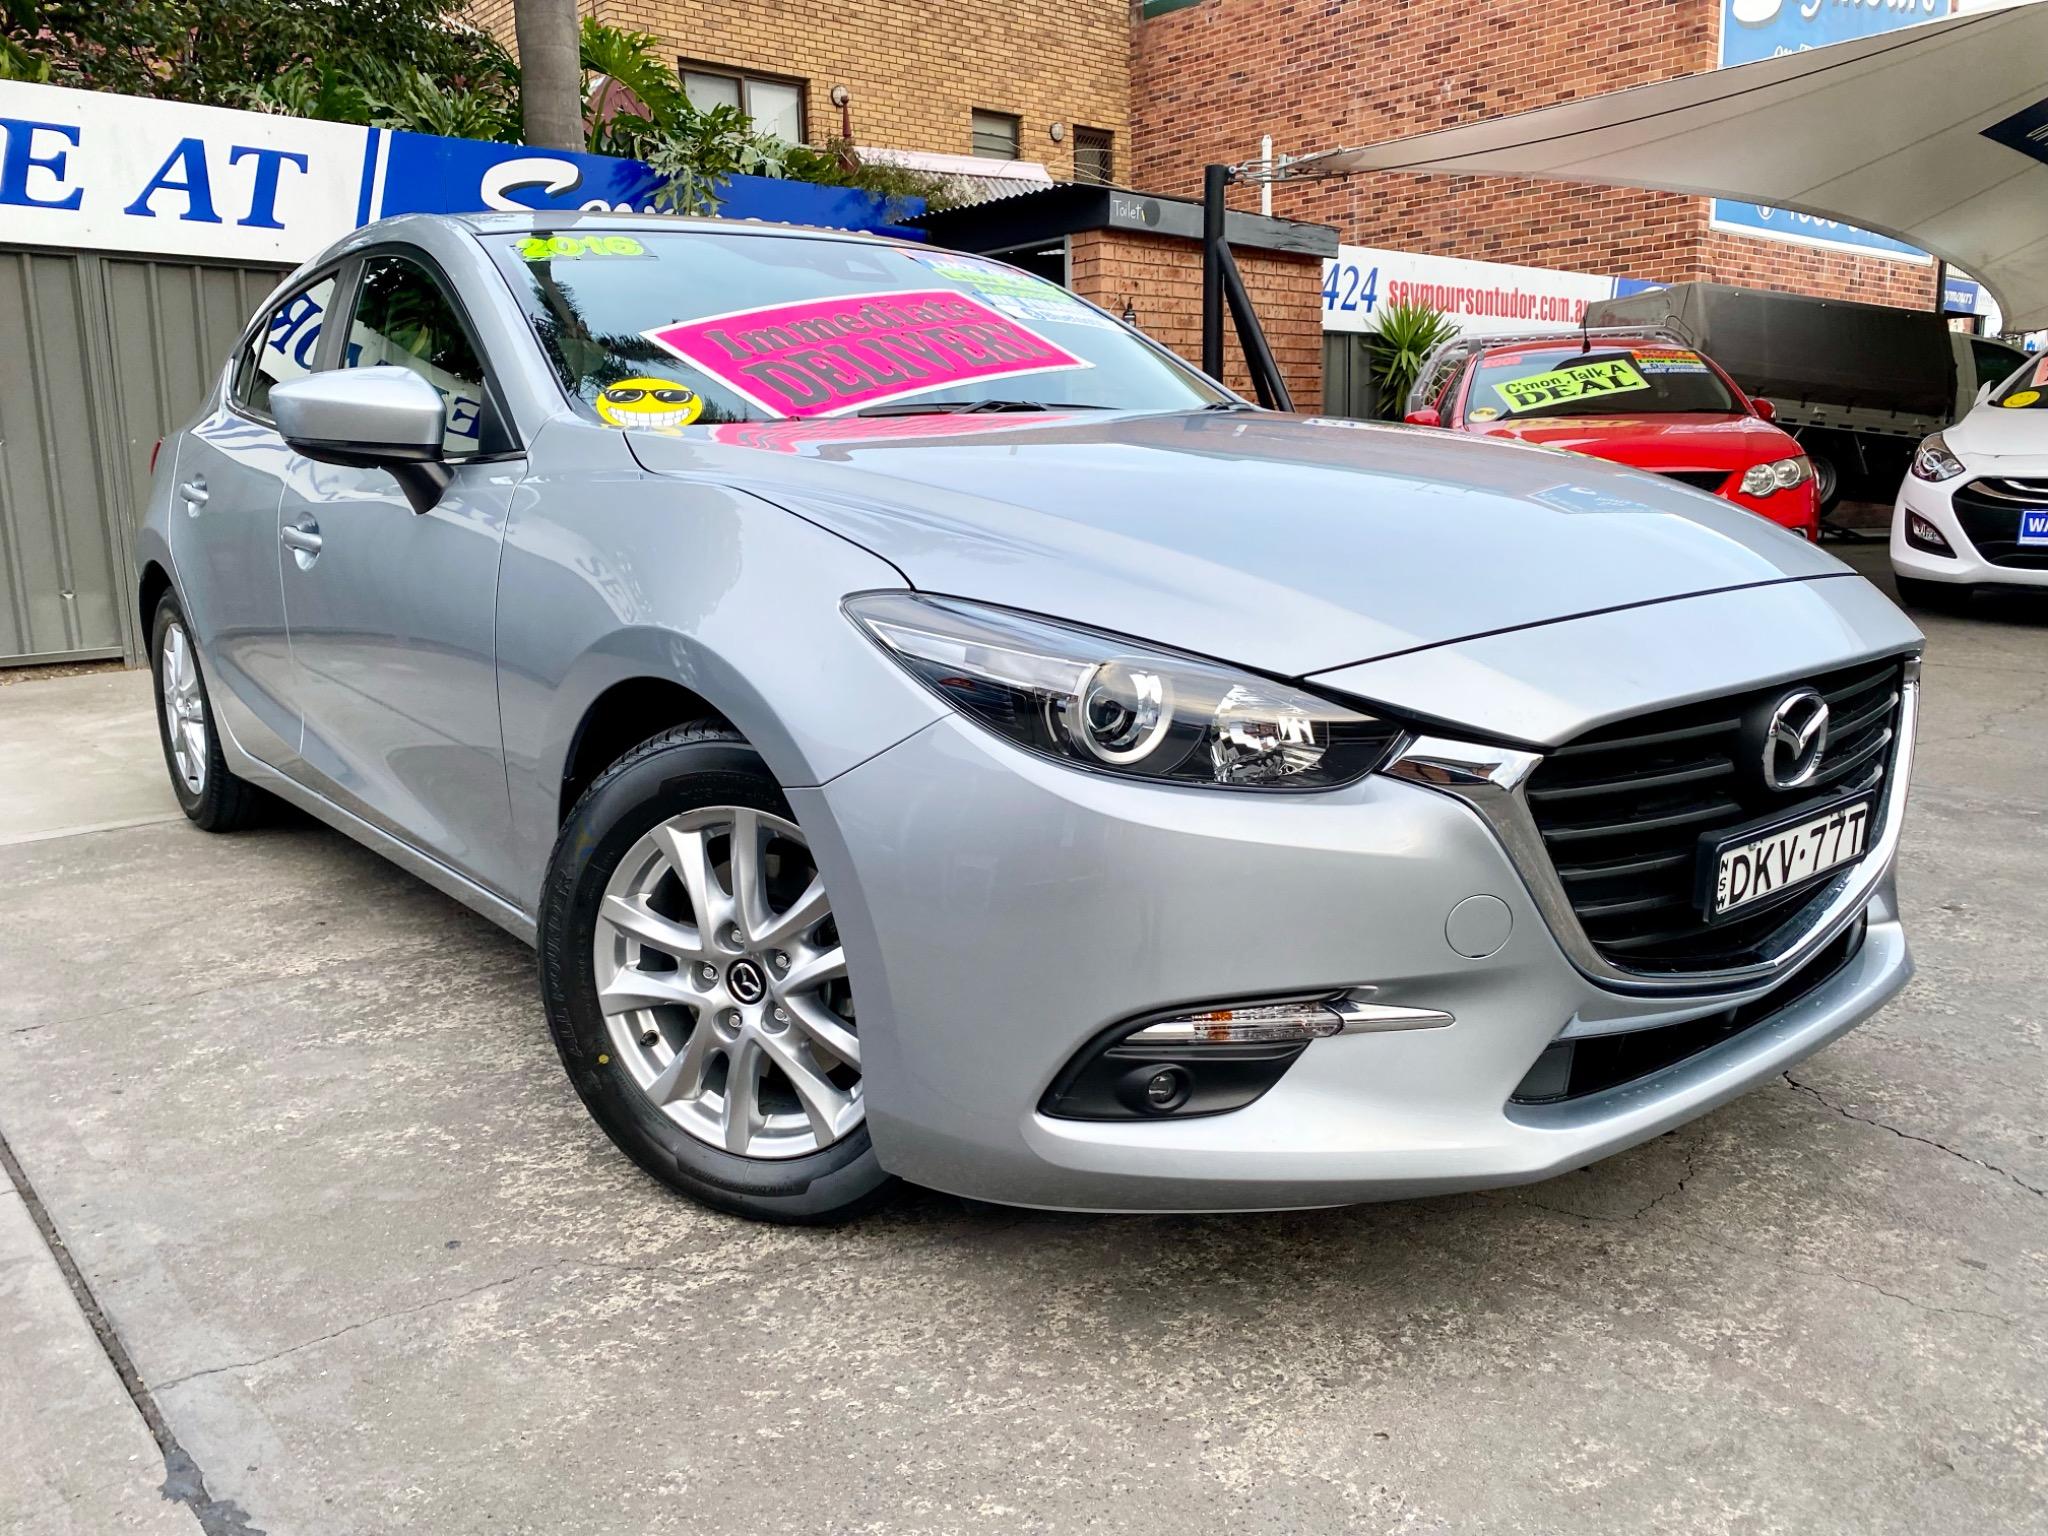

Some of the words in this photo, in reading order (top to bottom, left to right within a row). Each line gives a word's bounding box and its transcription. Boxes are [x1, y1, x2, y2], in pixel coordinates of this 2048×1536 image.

[123, 137, 309, 230] AT
[1112, 199, 1142, 220] Toilet
[1322, 263, 1379, 313] 424
[704, 299, 980, 360] Immediate
[740, 323, 1050, 405] DELIVERY
[1505, 376, 1562, 395] C'mon
[1565, 369, 1605, 383] Talk
[1610, 364, 1627, 375] A
[1514, 375, 1640, 407] DEAL
[1716, 858, 1728, 908] NSW
